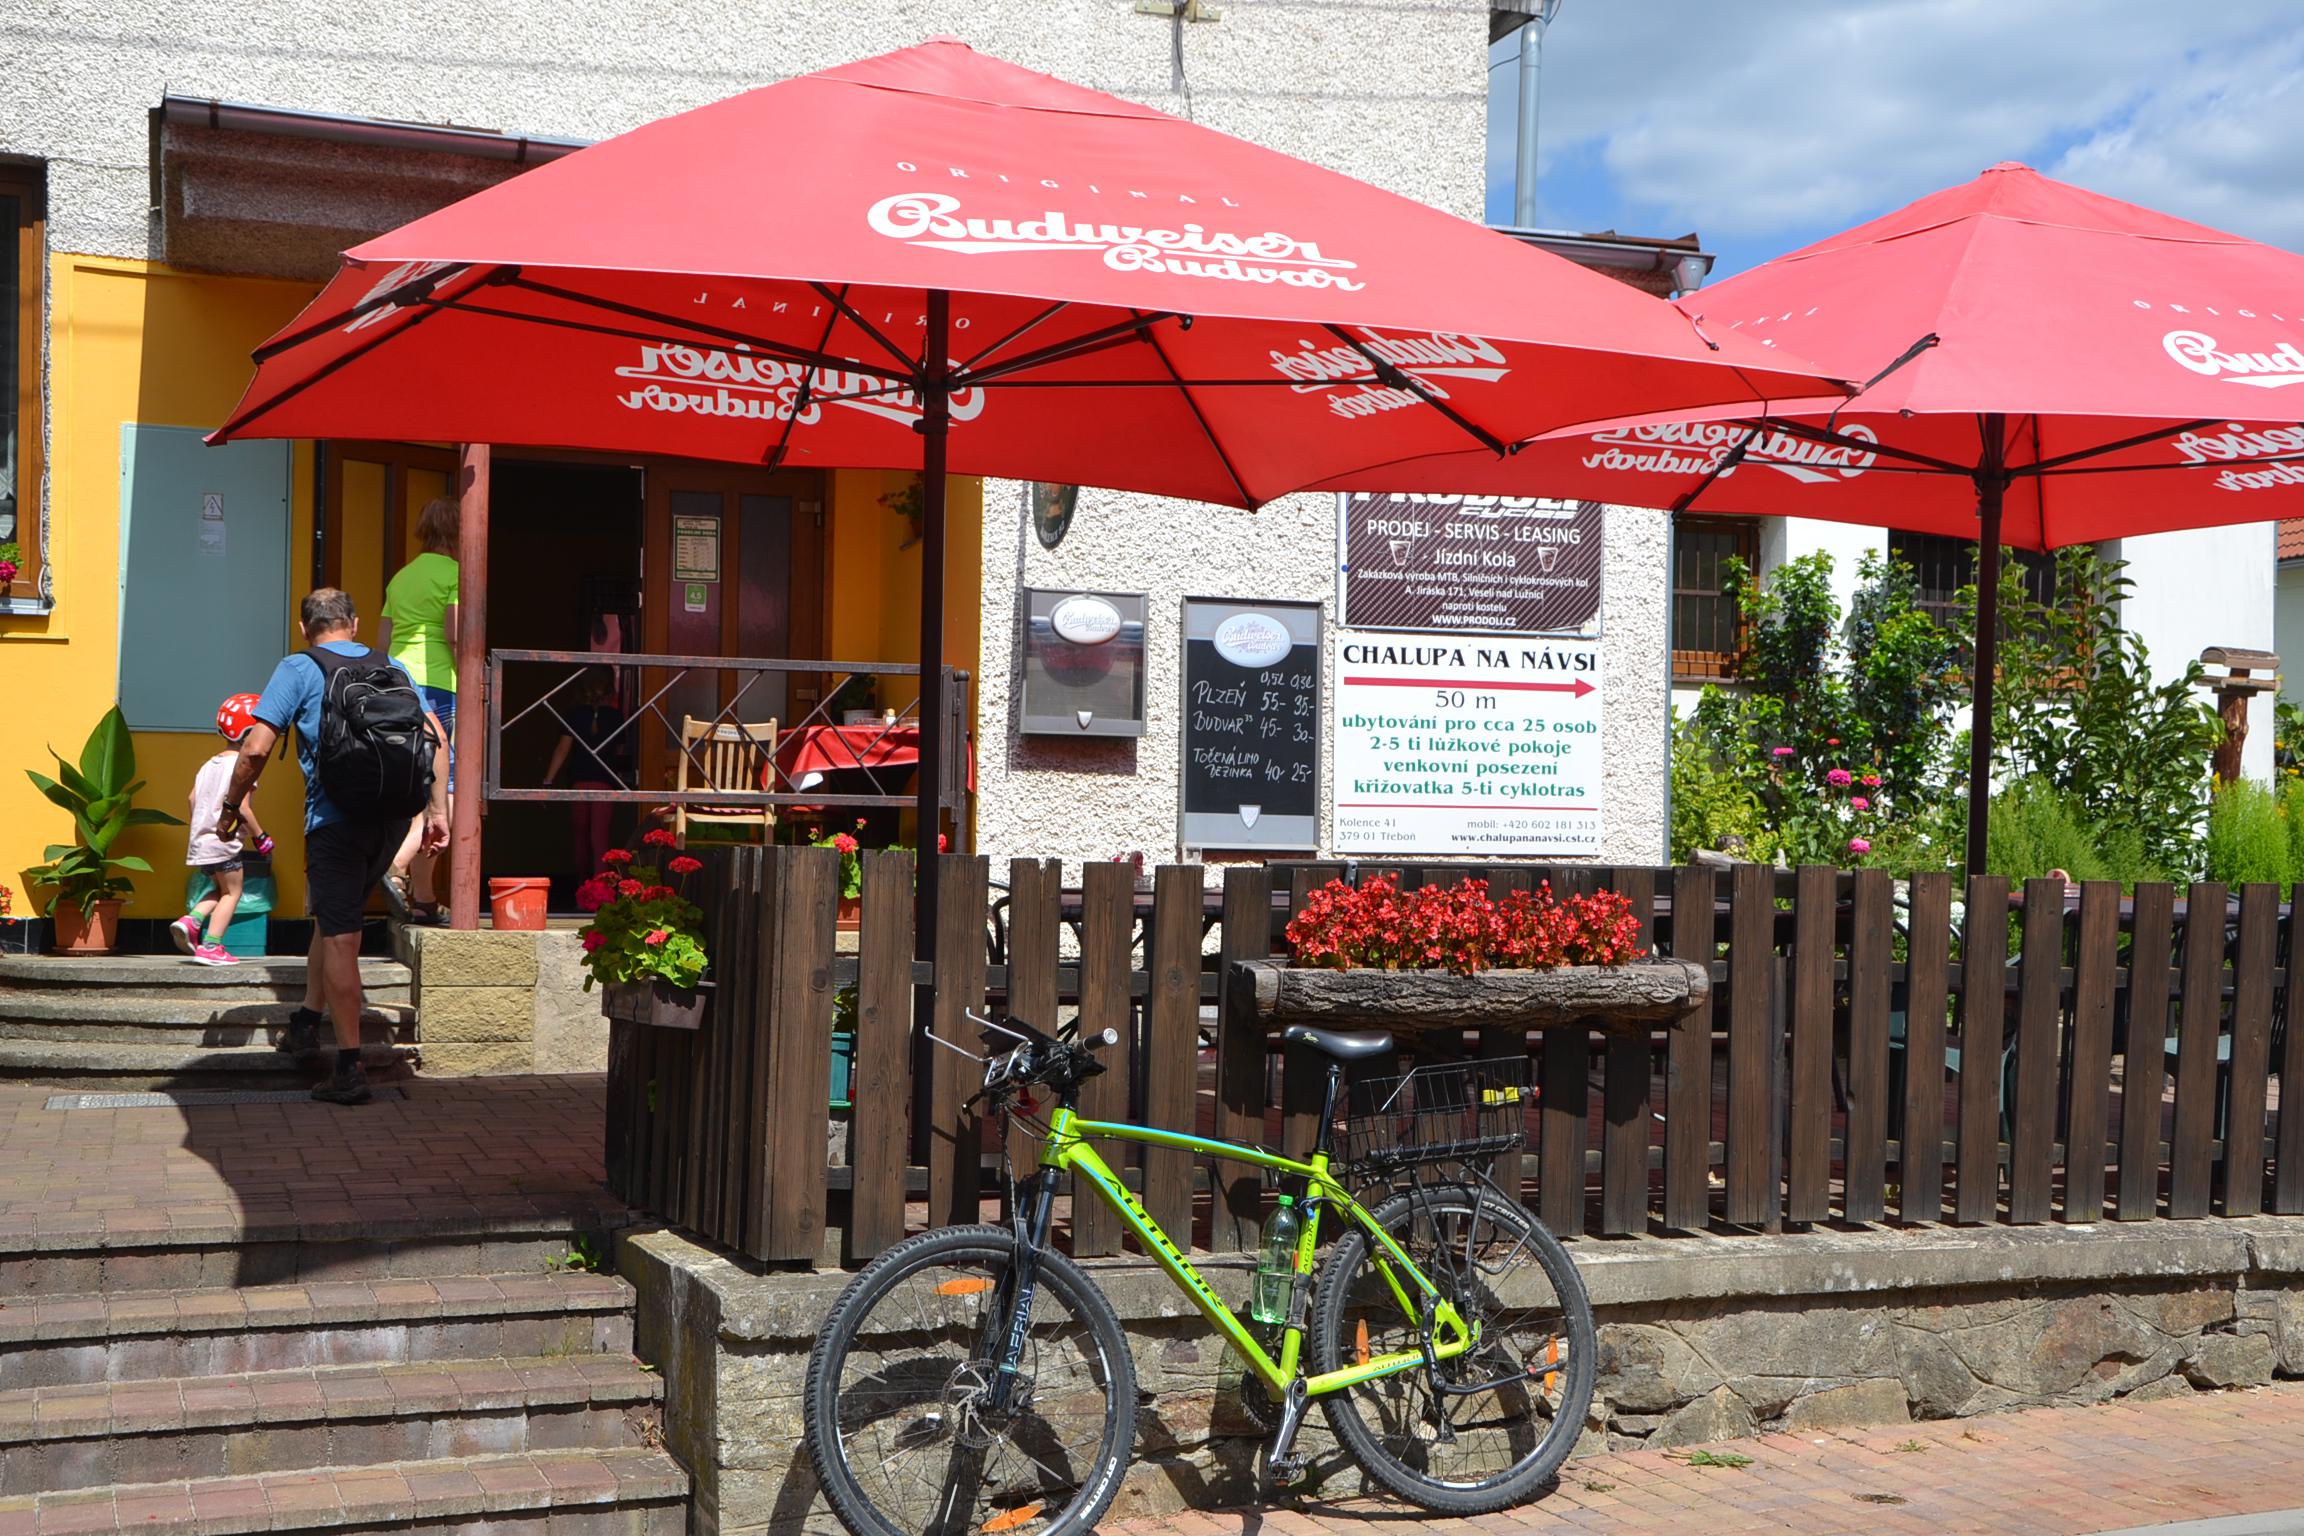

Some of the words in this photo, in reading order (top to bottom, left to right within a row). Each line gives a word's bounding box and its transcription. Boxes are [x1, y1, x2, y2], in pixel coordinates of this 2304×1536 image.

[897, 161, 1240, 208] ORIGINAL
[867, 192, 1357, 268] Budweiser
[1103, 244, 1365, 291] Budvar
[2133, 299, 2304, 323] ORIGI
[1459, 506, 1577, 520] cycles
[1367, 519, 1429, 538] PRODEJ
[1445, 522, 1500, 541] SERVIS
[1514, 526, 1581, 545] LEASING
[1433, 548, 1477, 566] Jízdní
[1483, 549, 1516, 567] Kola
[1438, 572, 1460, 583] MTB,
[1576, 577, 1589, 587] kol
[1496, 589, 1513, 599] nad
[1442, 602, 1474, 612] naproti
[1476, 603, 1507, 612] kostelu
[1432, 614, 1517, 626] WWW.PRODOLI.CZ
[1343, 645, 1466, 667] CHALUPA
[1477, 649, 1510, 668] NA
[1521, 646, 1596, 671] NÁVSI
[1435, 690, 1465, 709] 50
[1476, 695, 1496, 709] m
[1193, 710, 1244, 735] BUDVAR
[1342, 714, 1437, 731] ubytování
[1445, 719, 1476, 734] pro
[1484, 720, 1515, 731] cca
[1523, 718, 1545, 732] 25
[1552, 720, 1597, 734] osob
[1370, 736, 1400, 750] 2-5
[1409, 736, 1421, 751] ti
[1508, 739, 1572, 758] pokoje
[1383, 758, 1468, 773] venkovní
[1476, 761, 1558, 777] posezení
[1354, 778, 1454, 795] křižovatka
[1461, 781, 1492, 796] 5-ti
[1500, 782, 1585, 800] cyklotras
[1339, 817, 1381, 828] Kolence
[1384, 818, 1396, 828] 41
[1467, 819, 1499, 829] mobil:
[1503, 820, 1528, 829] +420
[1531, 820, 1551, 830] 602
[1556, 820, 1572, 830] 181
[1576, 821, 1597, 830] 313
[1339, 831, 1360, 841] 379
[1363, 831, 1376, 841] 01
[1451, 833, 1597, 844] www.chalupananavsi.cst.cz
[1481, 1200, 1496, 1209] ST
[1303, 1222, 1314, 1273] ACTION
[1080, 1477, 1109, 1520] CRITTER
